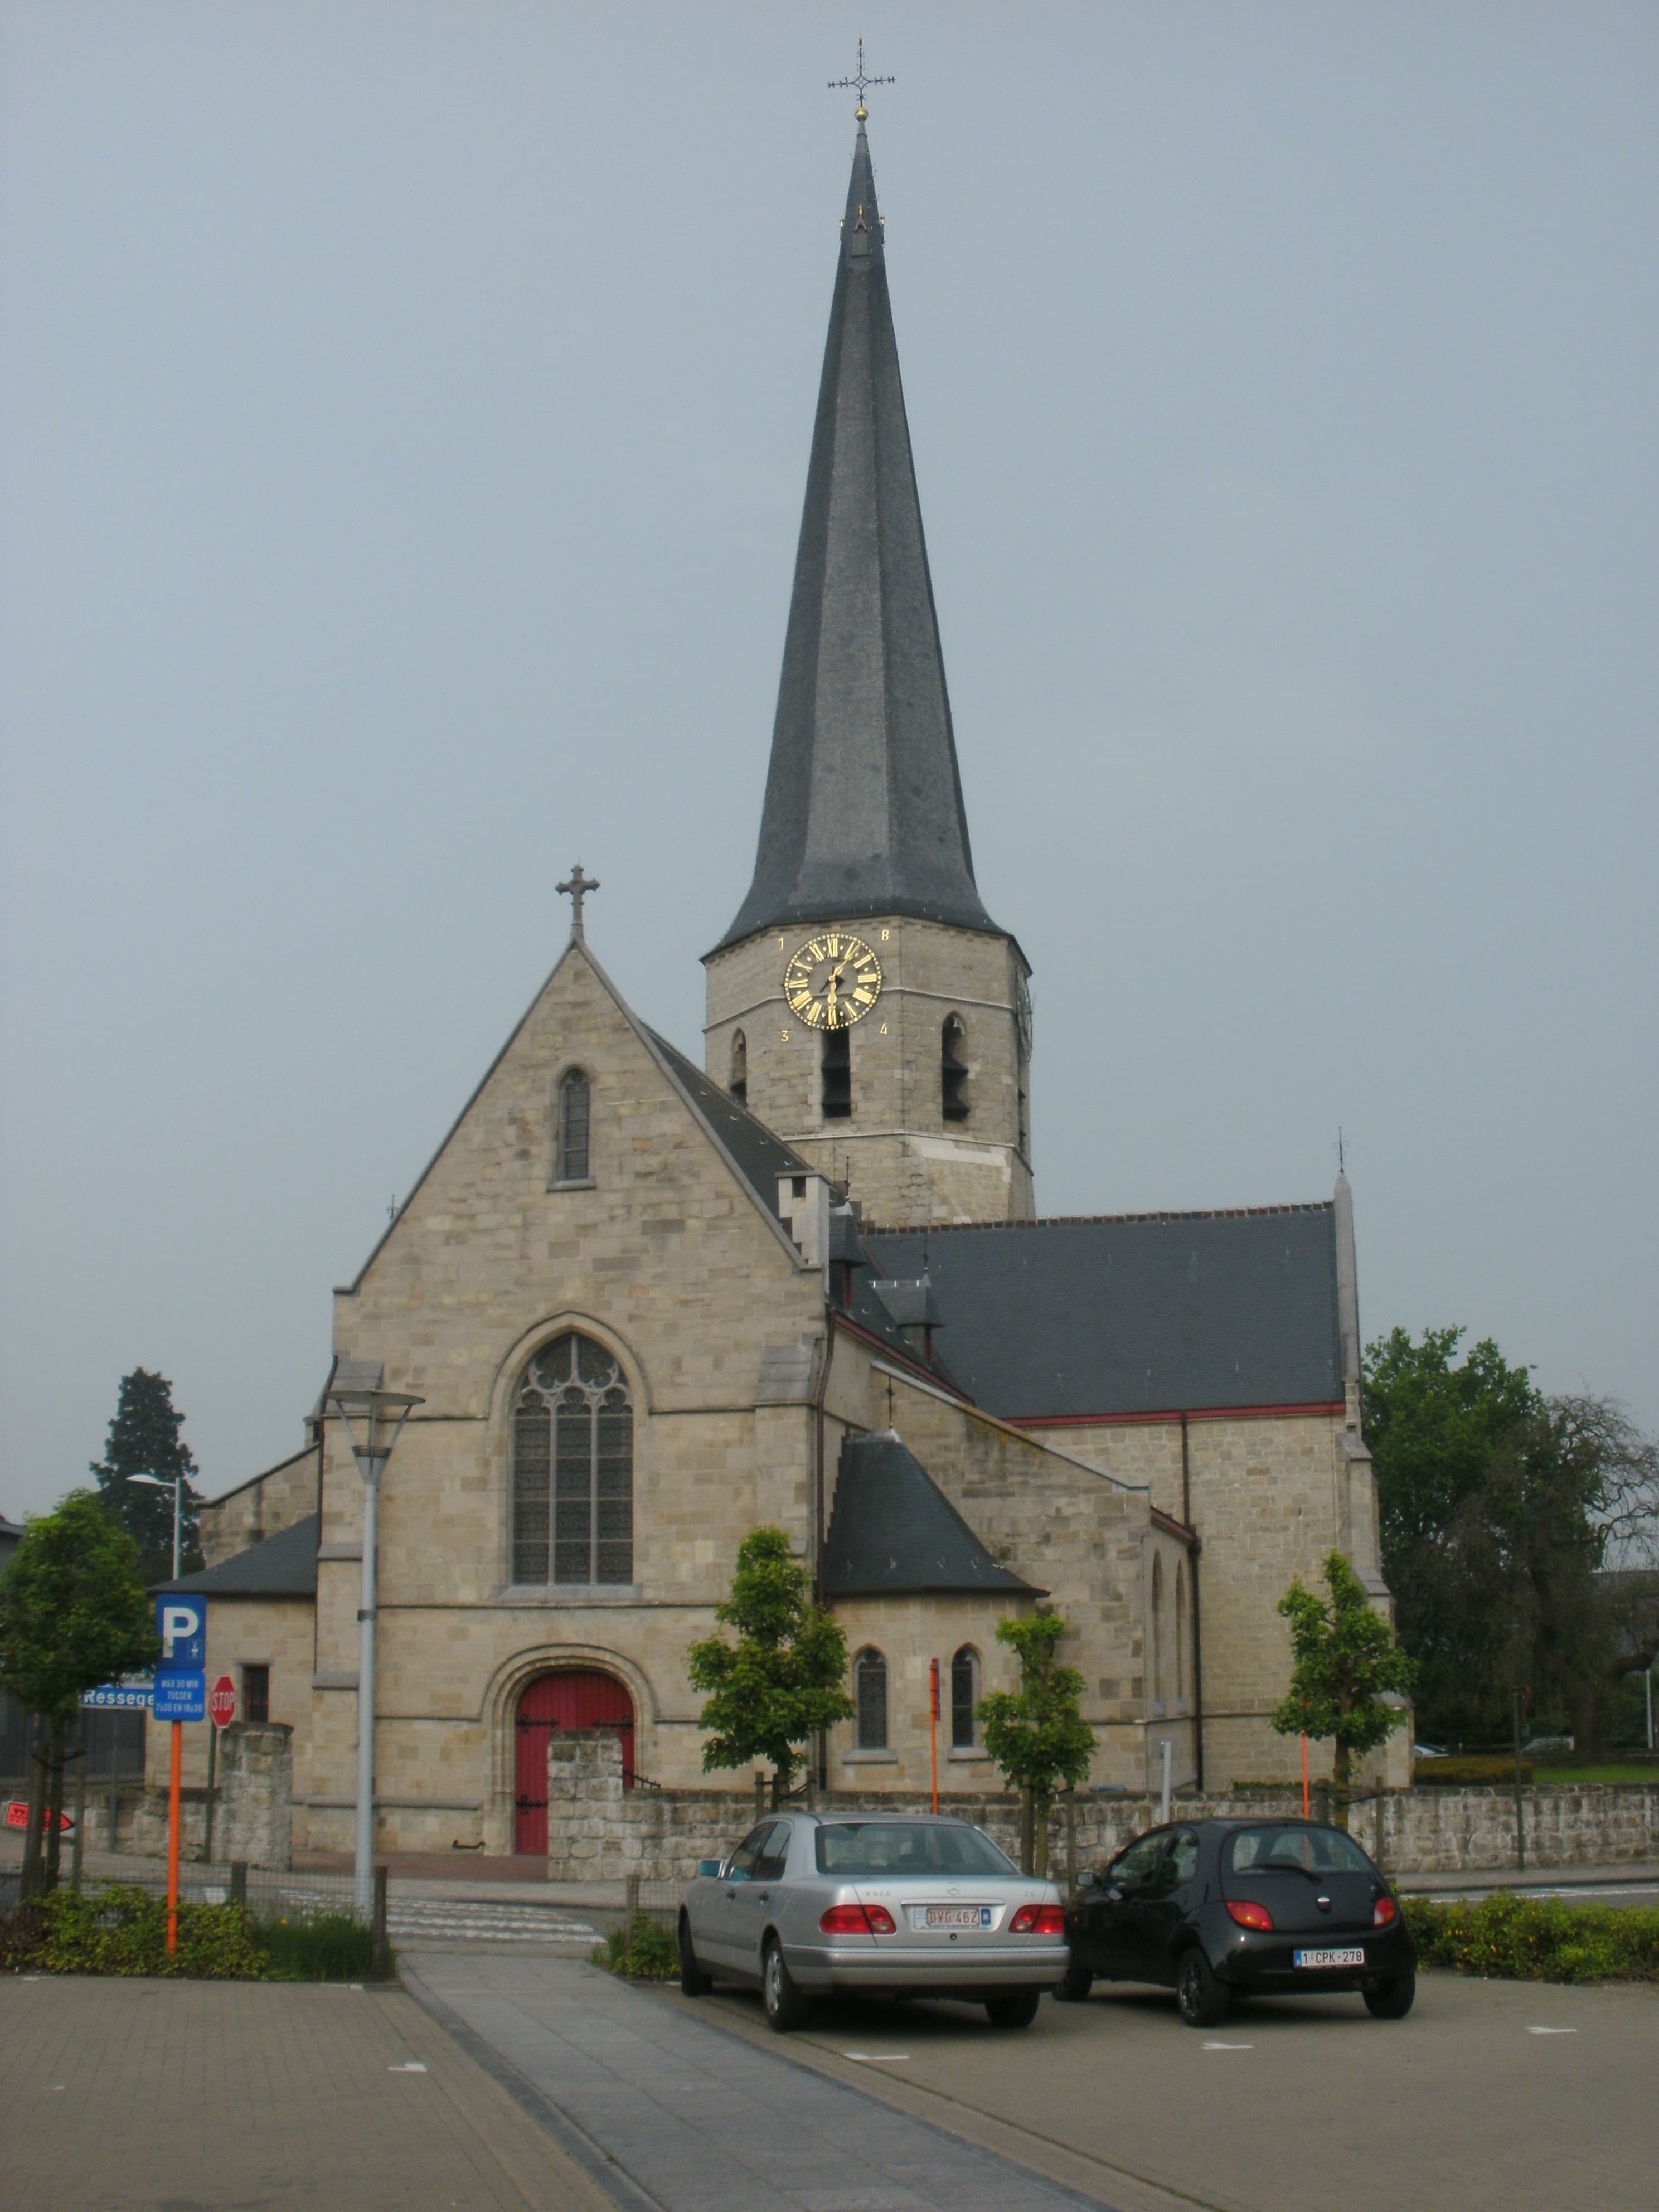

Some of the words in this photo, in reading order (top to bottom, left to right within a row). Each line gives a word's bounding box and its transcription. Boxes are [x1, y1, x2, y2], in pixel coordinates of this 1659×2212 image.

[881, 929, 889, 941] 8
[778, 937, 784, 950] 1
[827, 938, 838, 957] XII
[809, 943, 824, 962] XI
[794, 959, 812, 972] X
[853, 954, 872, 969] II
[789, 979, 808, 988] IX
[858, 974, 877, 983] III
[792, 990, 812, 1010] VIII
[807, 1002, 822, 1022] VII
[845, 1001, 857, 1018] V
[880, 1023, 887, 1035] 4
[781, 1030, 788, 1042] 3
[163, 1607, 198, 1658] P
[161, 1679, 174, 1688] MAX
[176, 1680, 185, 1688] 30
[186, 1680, 198, 1688] MIN
[84, 1690, 154, 1707] Ressege
[167, 1691, 192, 1700] TUSSEN
[212, 1692, 235, 1711] STOP
[173, 1704, 182, 1713] EN
